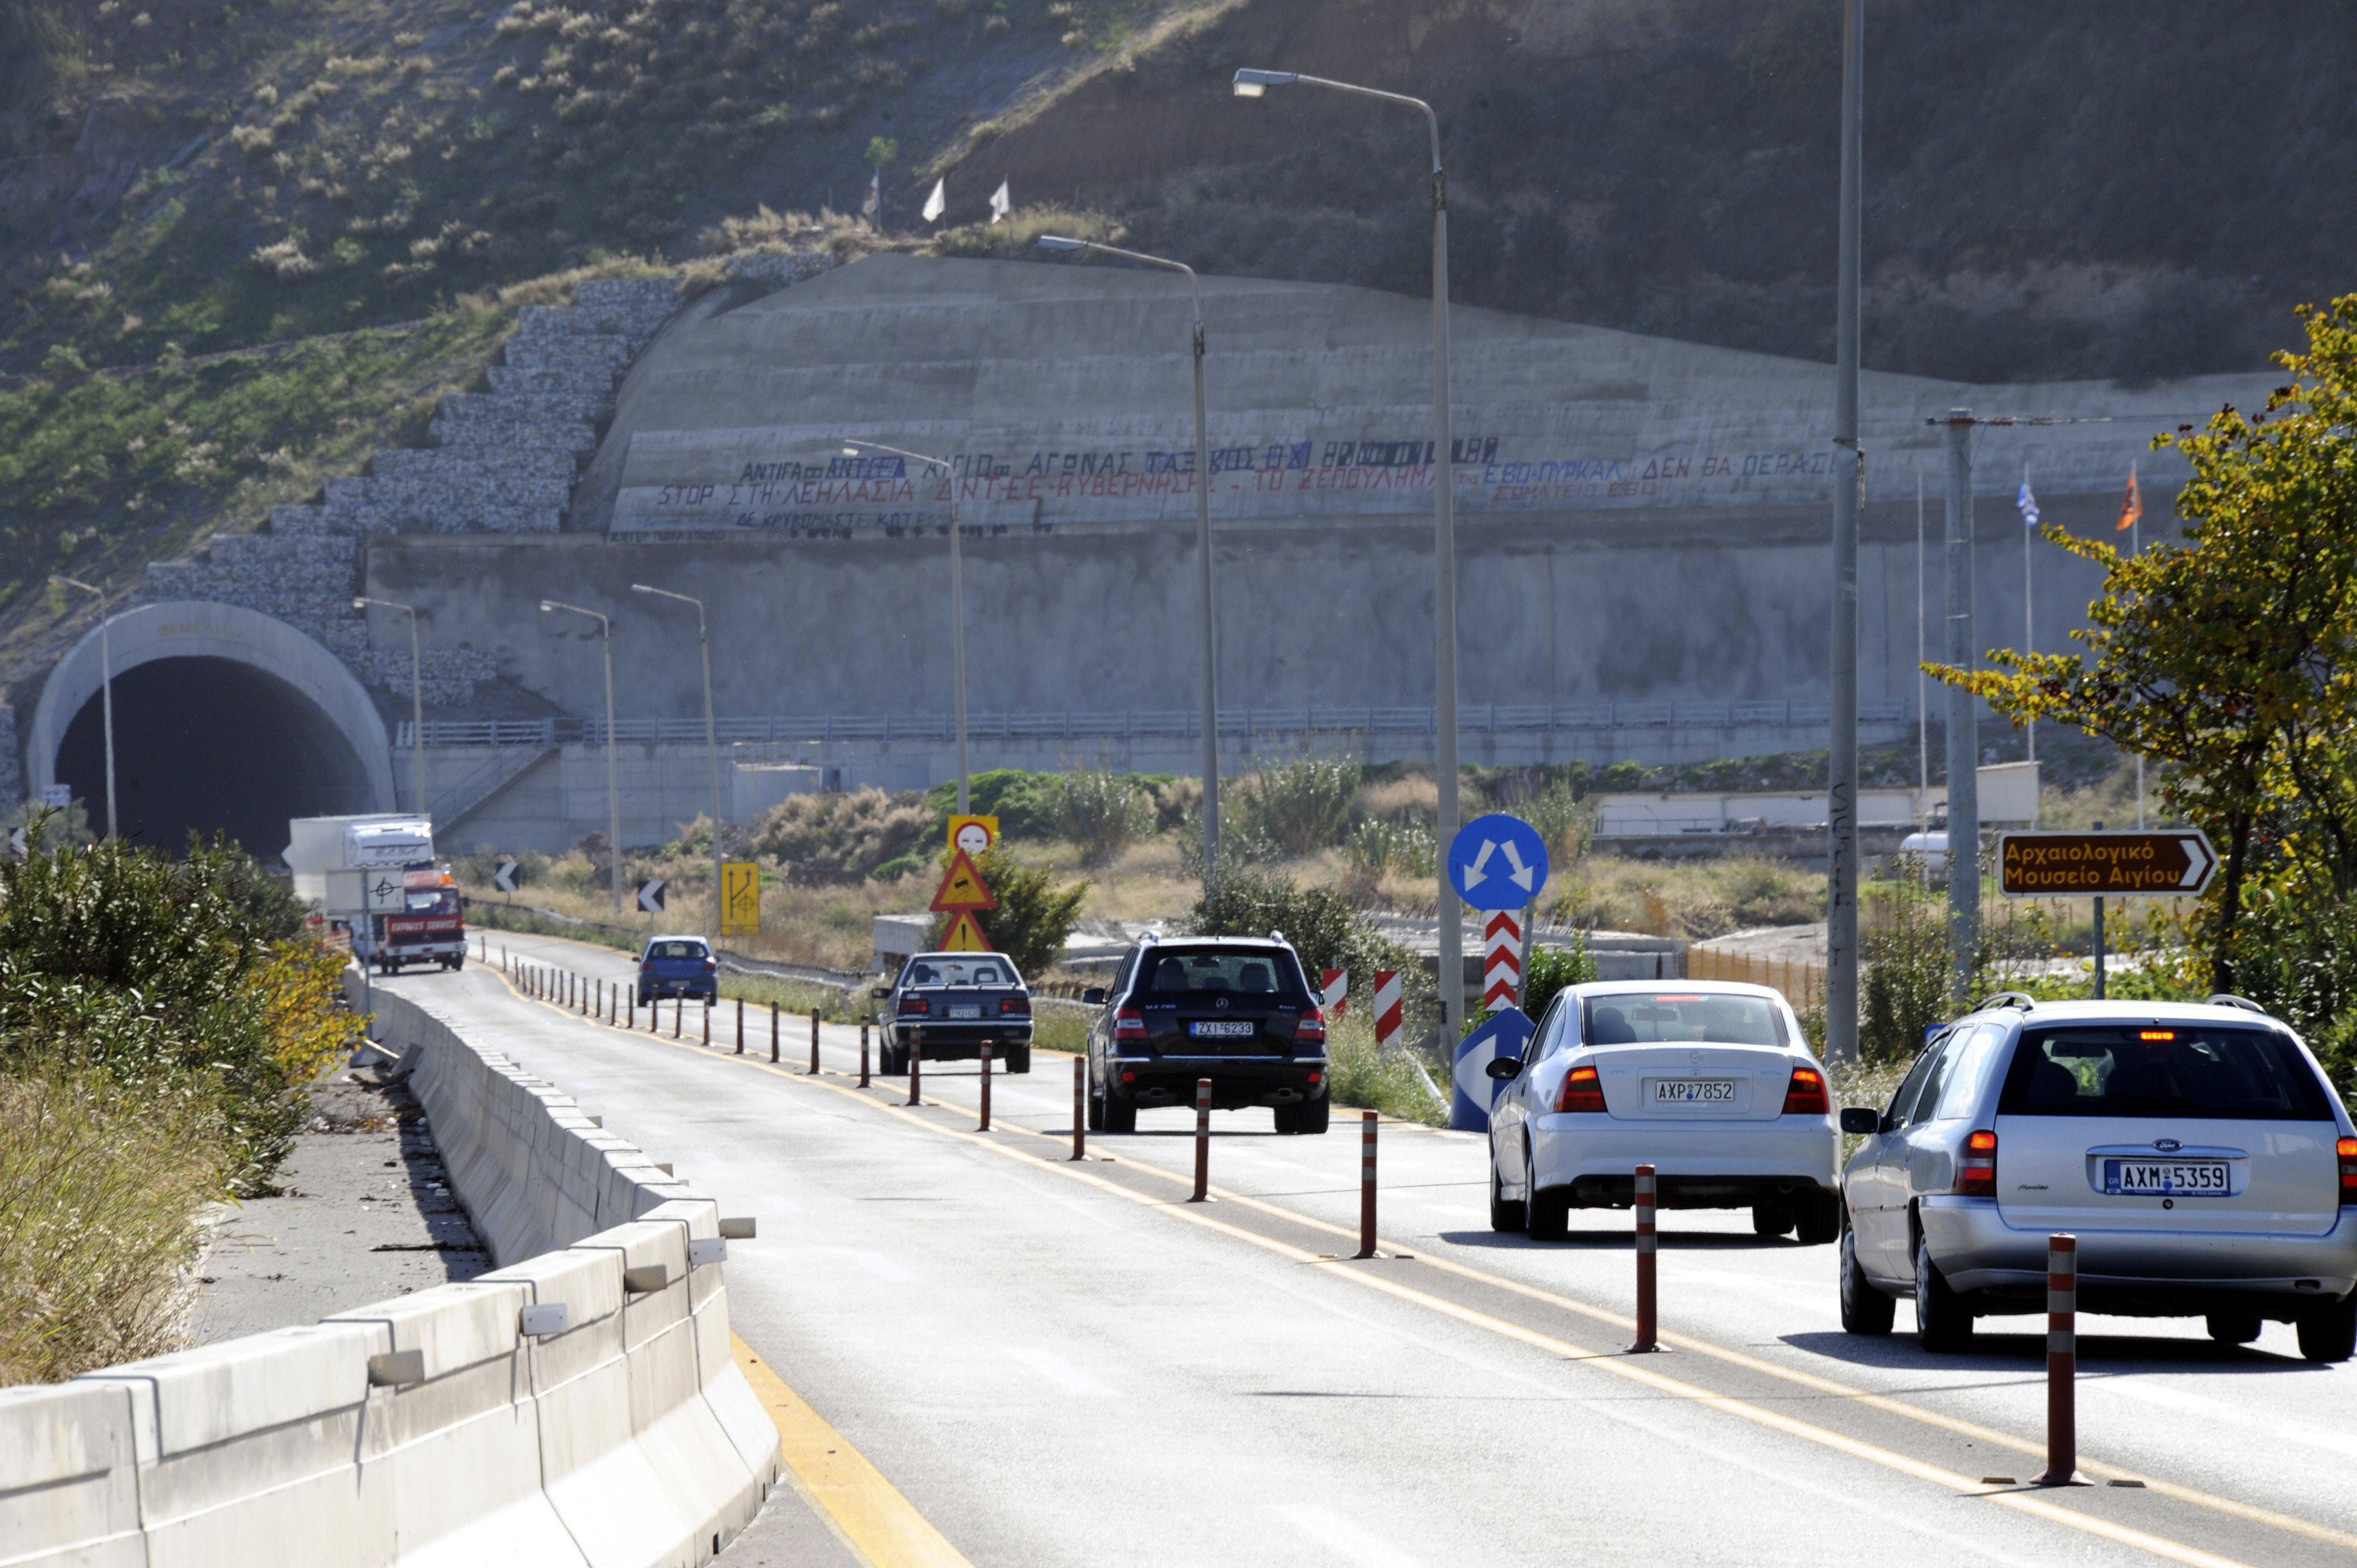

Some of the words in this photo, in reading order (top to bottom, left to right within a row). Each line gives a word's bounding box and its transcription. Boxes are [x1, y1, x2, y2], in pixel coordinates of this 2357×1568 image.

[658, 484, 714, 505] STOP
[728, 483, 776, 505] ΣΤΗ
[1643, 457, 1692, 480] ΔΕΝ
[2005, 841, 2155, 865] Αρχαιολογικό
[2004, 866, 2100, 885] Μουσείο
[2108, 865, 2180, 888] Αιγίου
